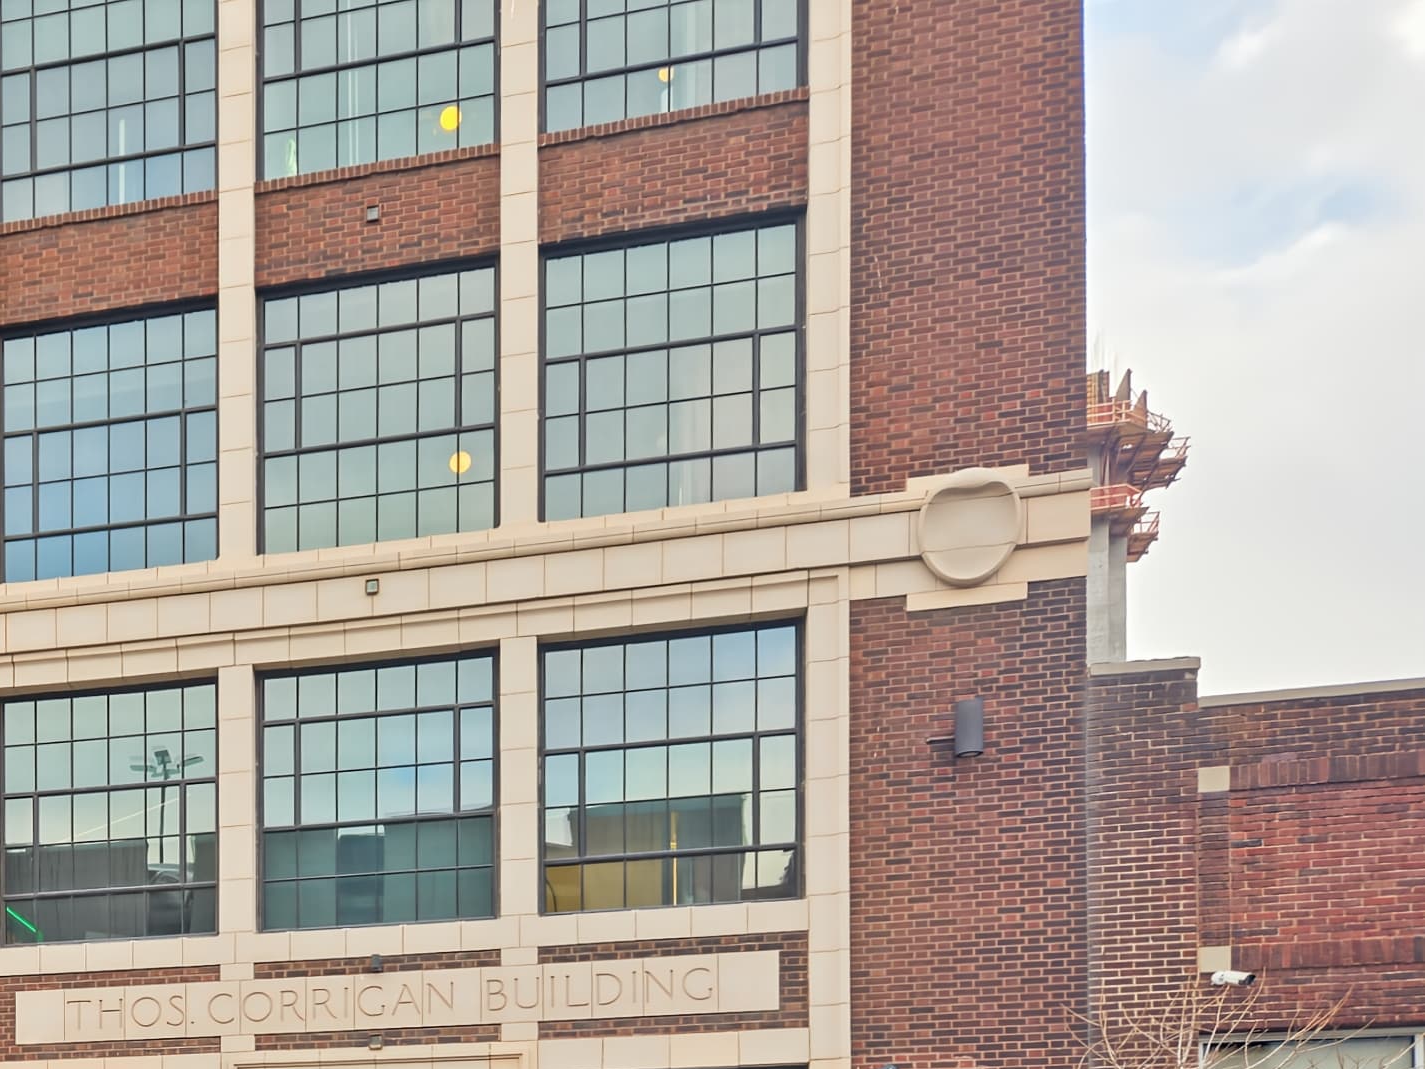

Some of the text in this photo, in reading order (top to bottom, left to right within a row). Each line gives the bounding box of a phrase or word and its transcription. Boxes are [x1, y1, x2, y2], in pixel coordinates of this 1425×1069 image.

[66, 967, 713, 1031] THOS. CORRIGAN BUILDING
